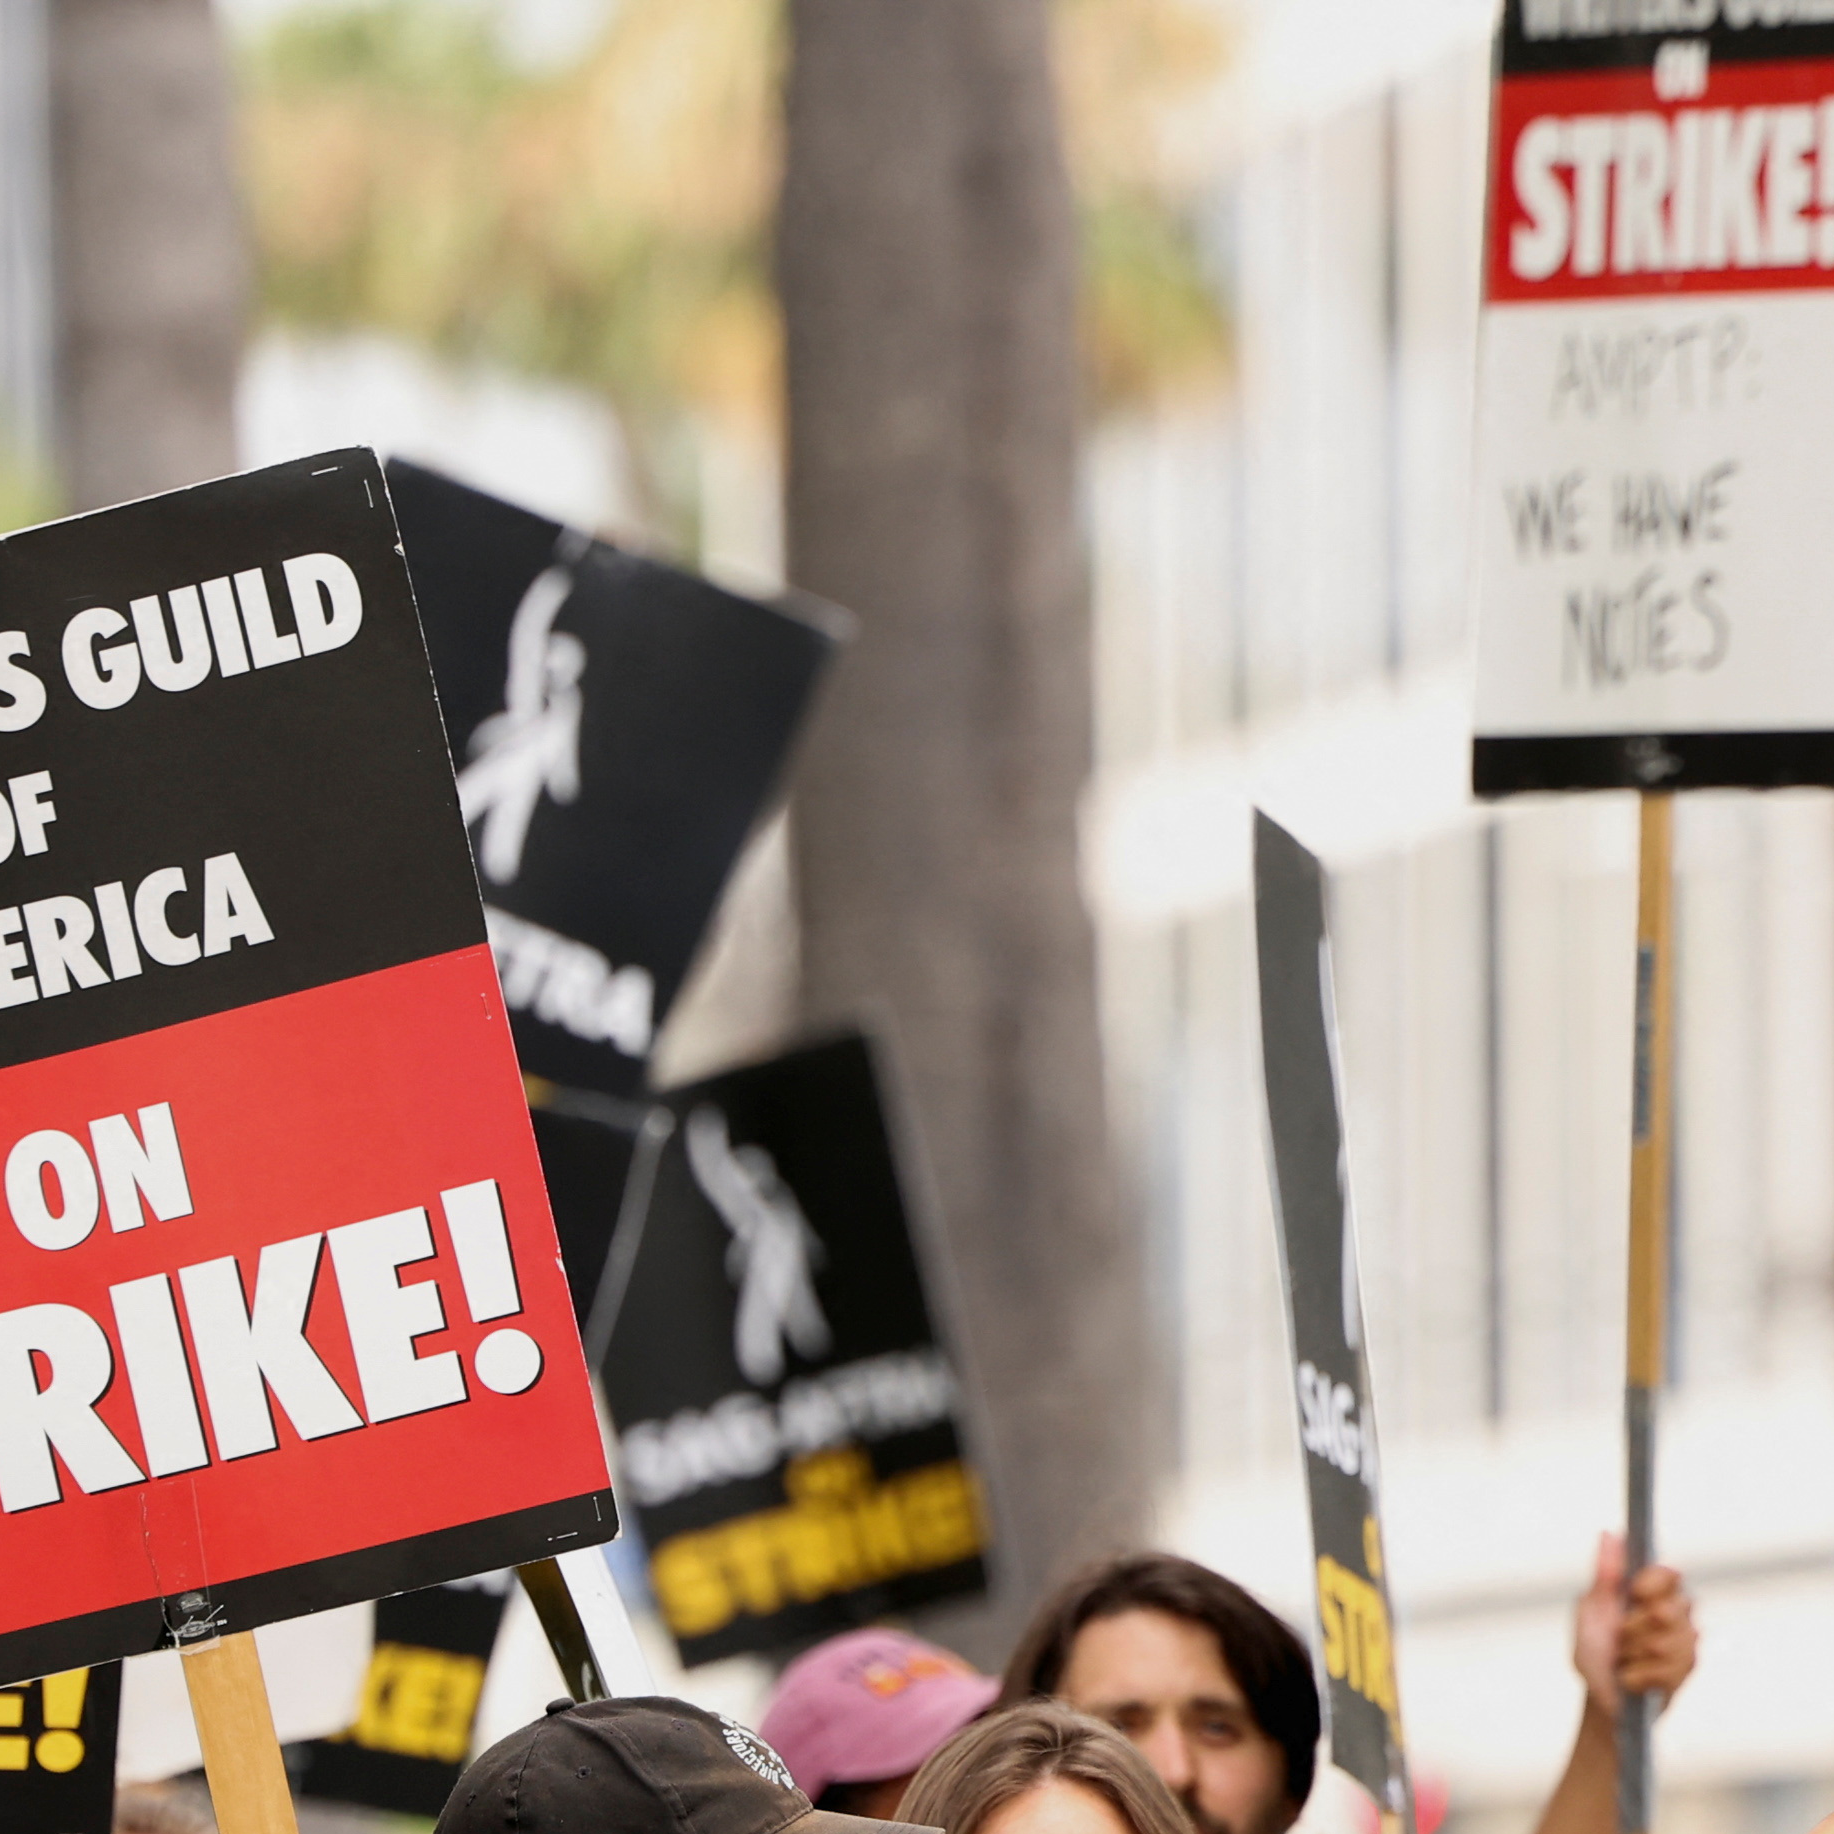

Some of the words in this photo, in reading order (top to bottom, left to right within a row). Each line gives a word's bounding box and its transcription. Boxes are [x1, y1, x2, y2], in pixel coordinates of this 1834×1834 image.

[1503, 467, 1586, 564] WE
[1611, 459, 1740, 557] HAVE
[61, 553, 362, 710] GUILD
[1562, 569, 1728, 694] NOTES
[5, 1101, 194, 1251] ON
[723, 1729, 779, 1785] DIRECTORS
